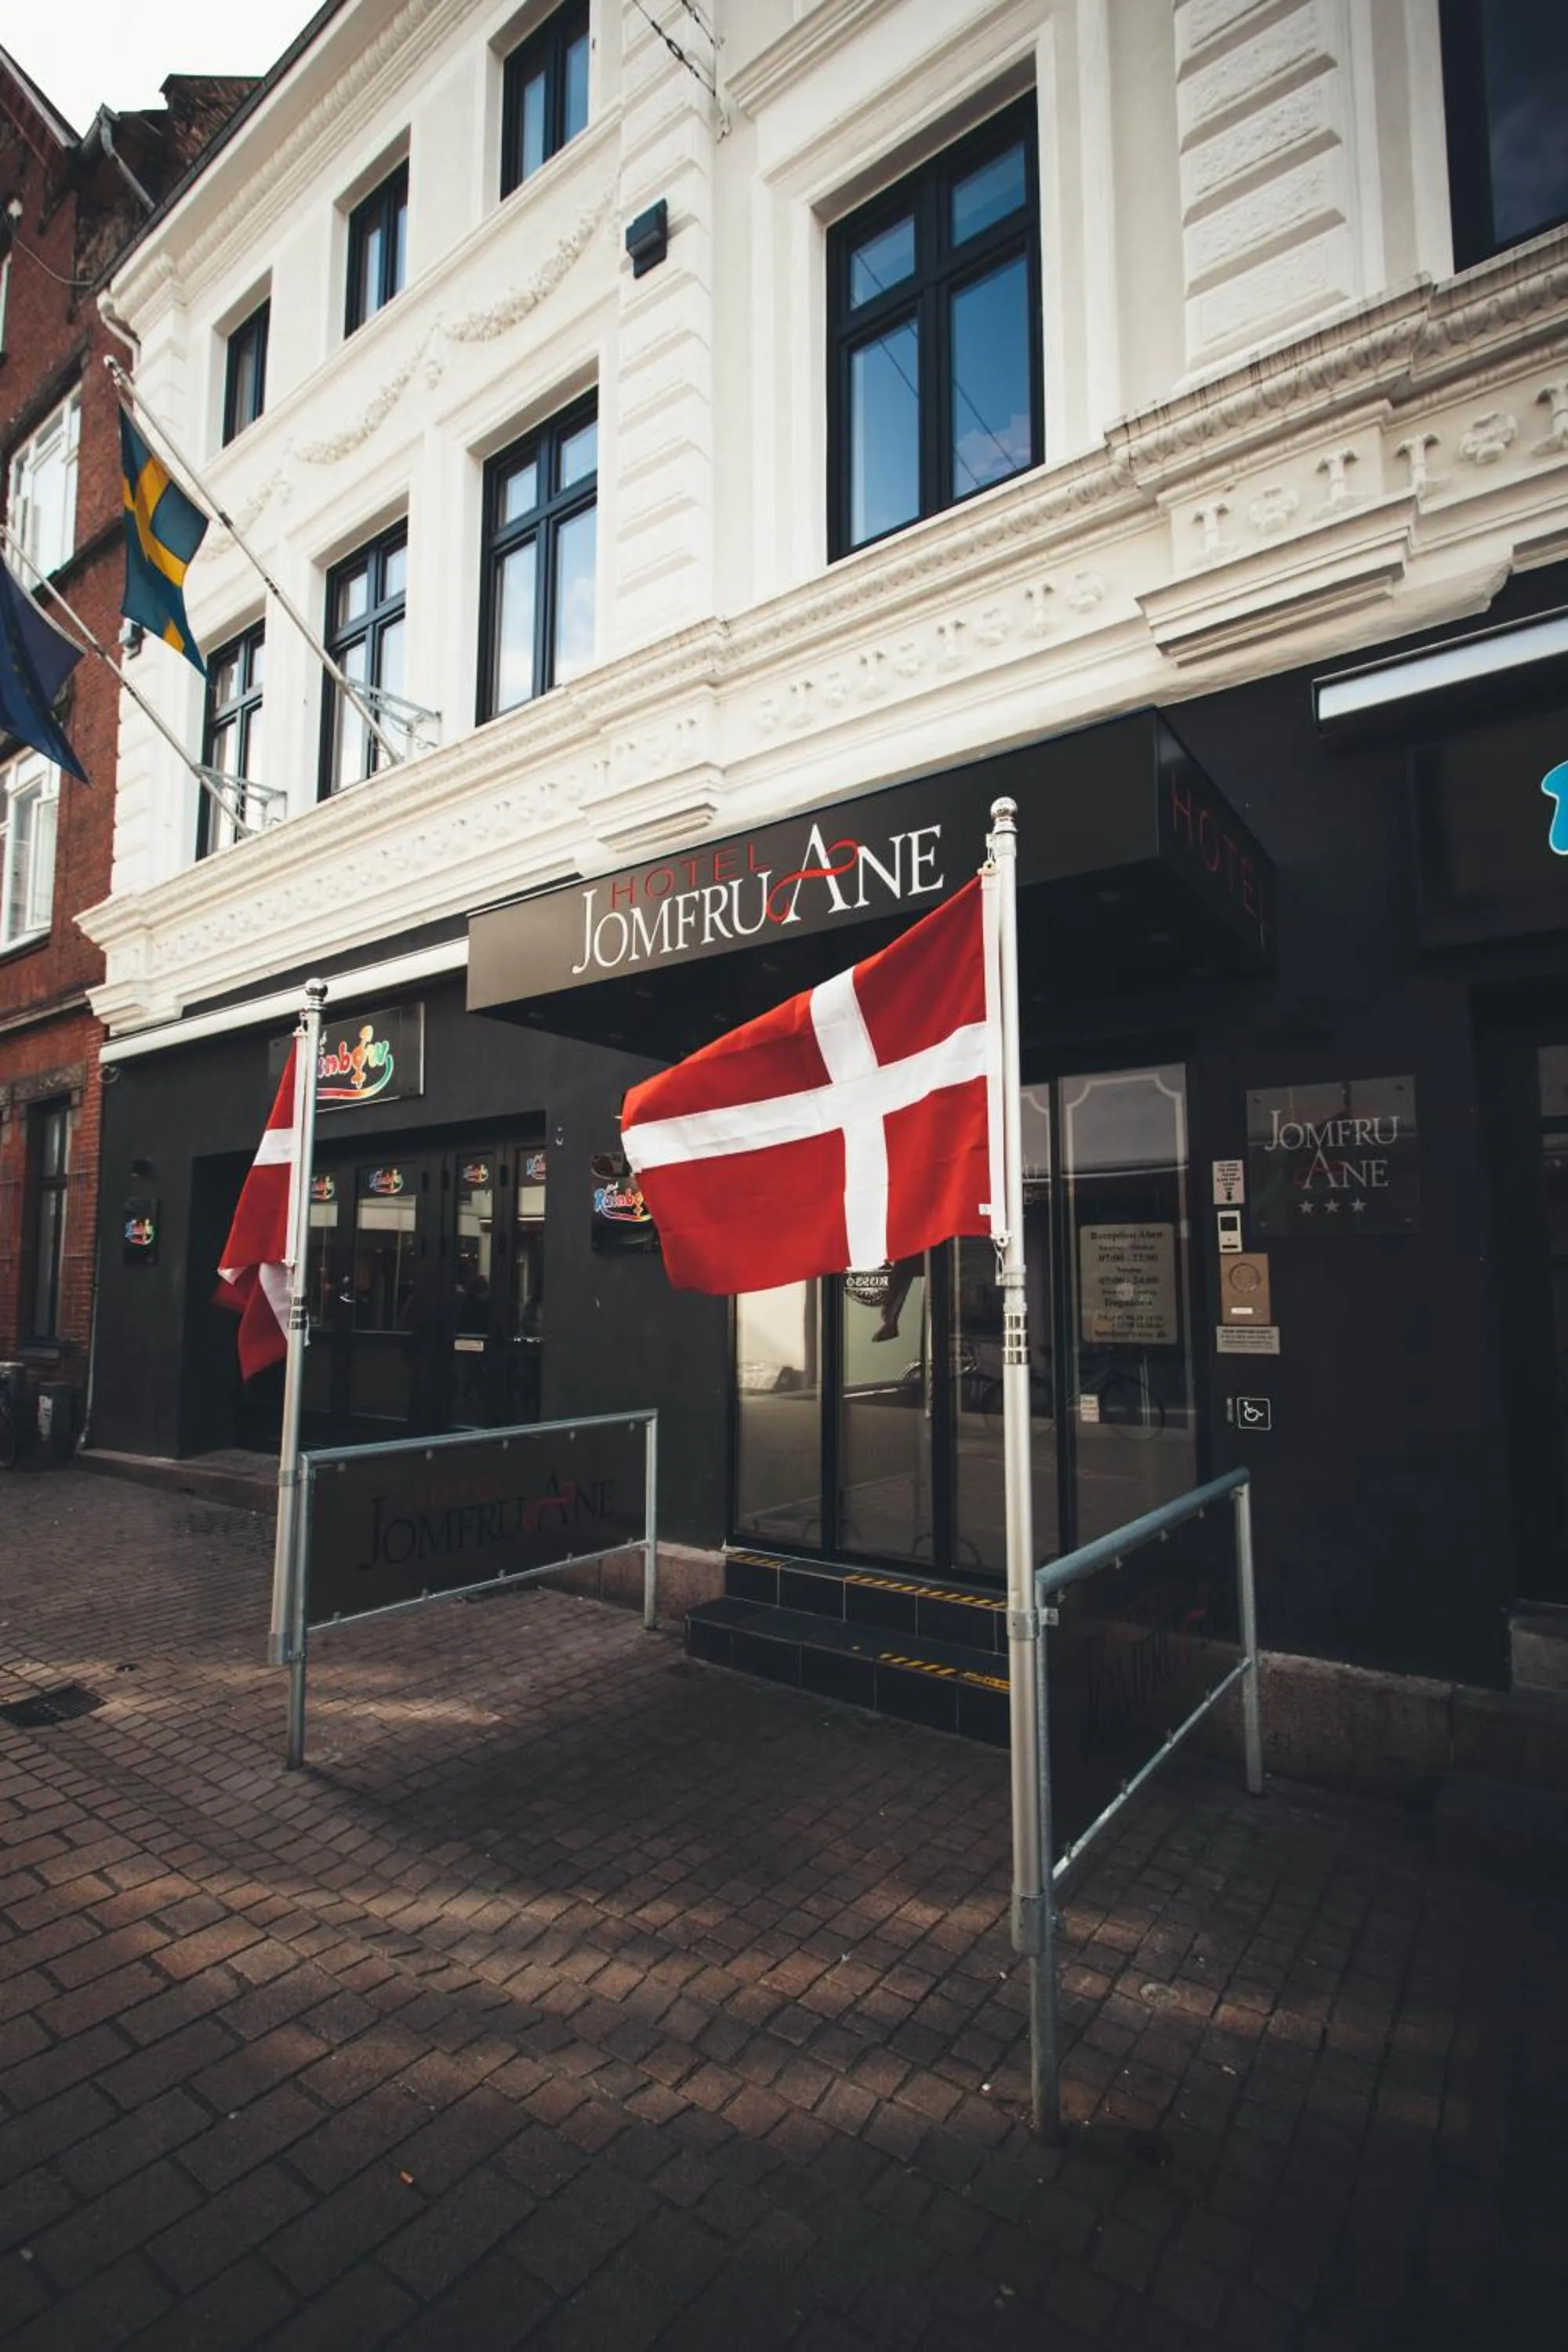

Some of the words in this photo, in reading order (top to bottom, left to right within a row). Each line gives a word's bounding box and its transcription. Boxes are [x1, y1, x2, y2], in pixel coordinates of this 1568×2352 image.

[612, 843, 771, 909] HOTEL
[1171, 771, 1265, 926] HOTEL
[572, 869, 772, 975] JOMFRU
[782, 822, 944, 925] ANE
[1264, 1109, 1400, 1151] JOMFRU
[1303, 1148, 1389, 1189] ANE
[358, 1497, 526, 1571] JOMFRU
